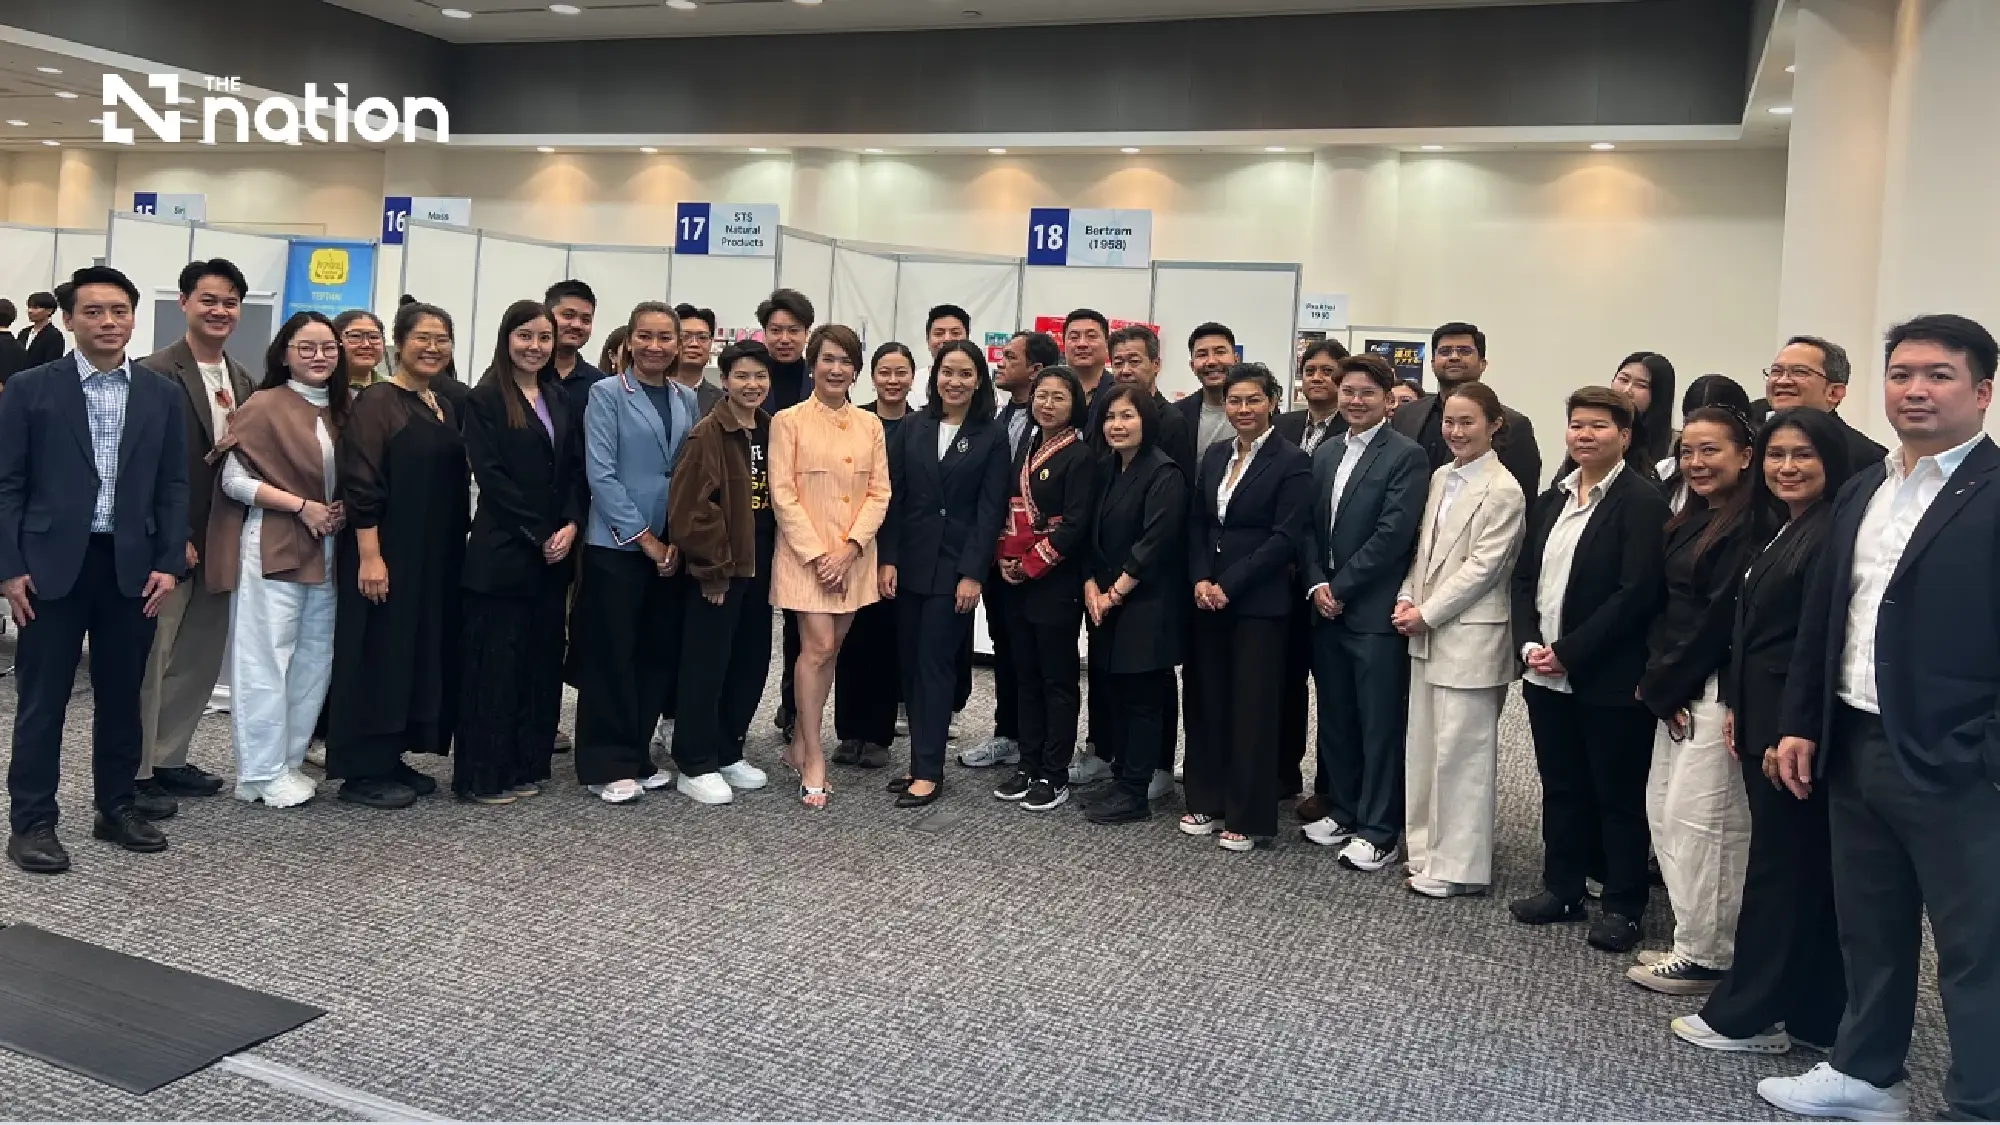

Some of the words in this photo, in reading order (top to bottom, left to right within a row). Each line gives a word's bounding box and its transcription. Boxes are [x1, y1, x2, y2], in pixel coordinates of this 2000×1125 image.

[386, 211, 406, 232] 16
[734, 212, 753, 222] STS
[680, 216, 706, 241] 17
[725, 225, 761, 235] Natural
[1085, 225, 1132, 236] Bertram
[721, 236, 764, 247] Products
[1034, 224, 1063, 250] 18
[1088, 240, 1127, 251] (1958)
